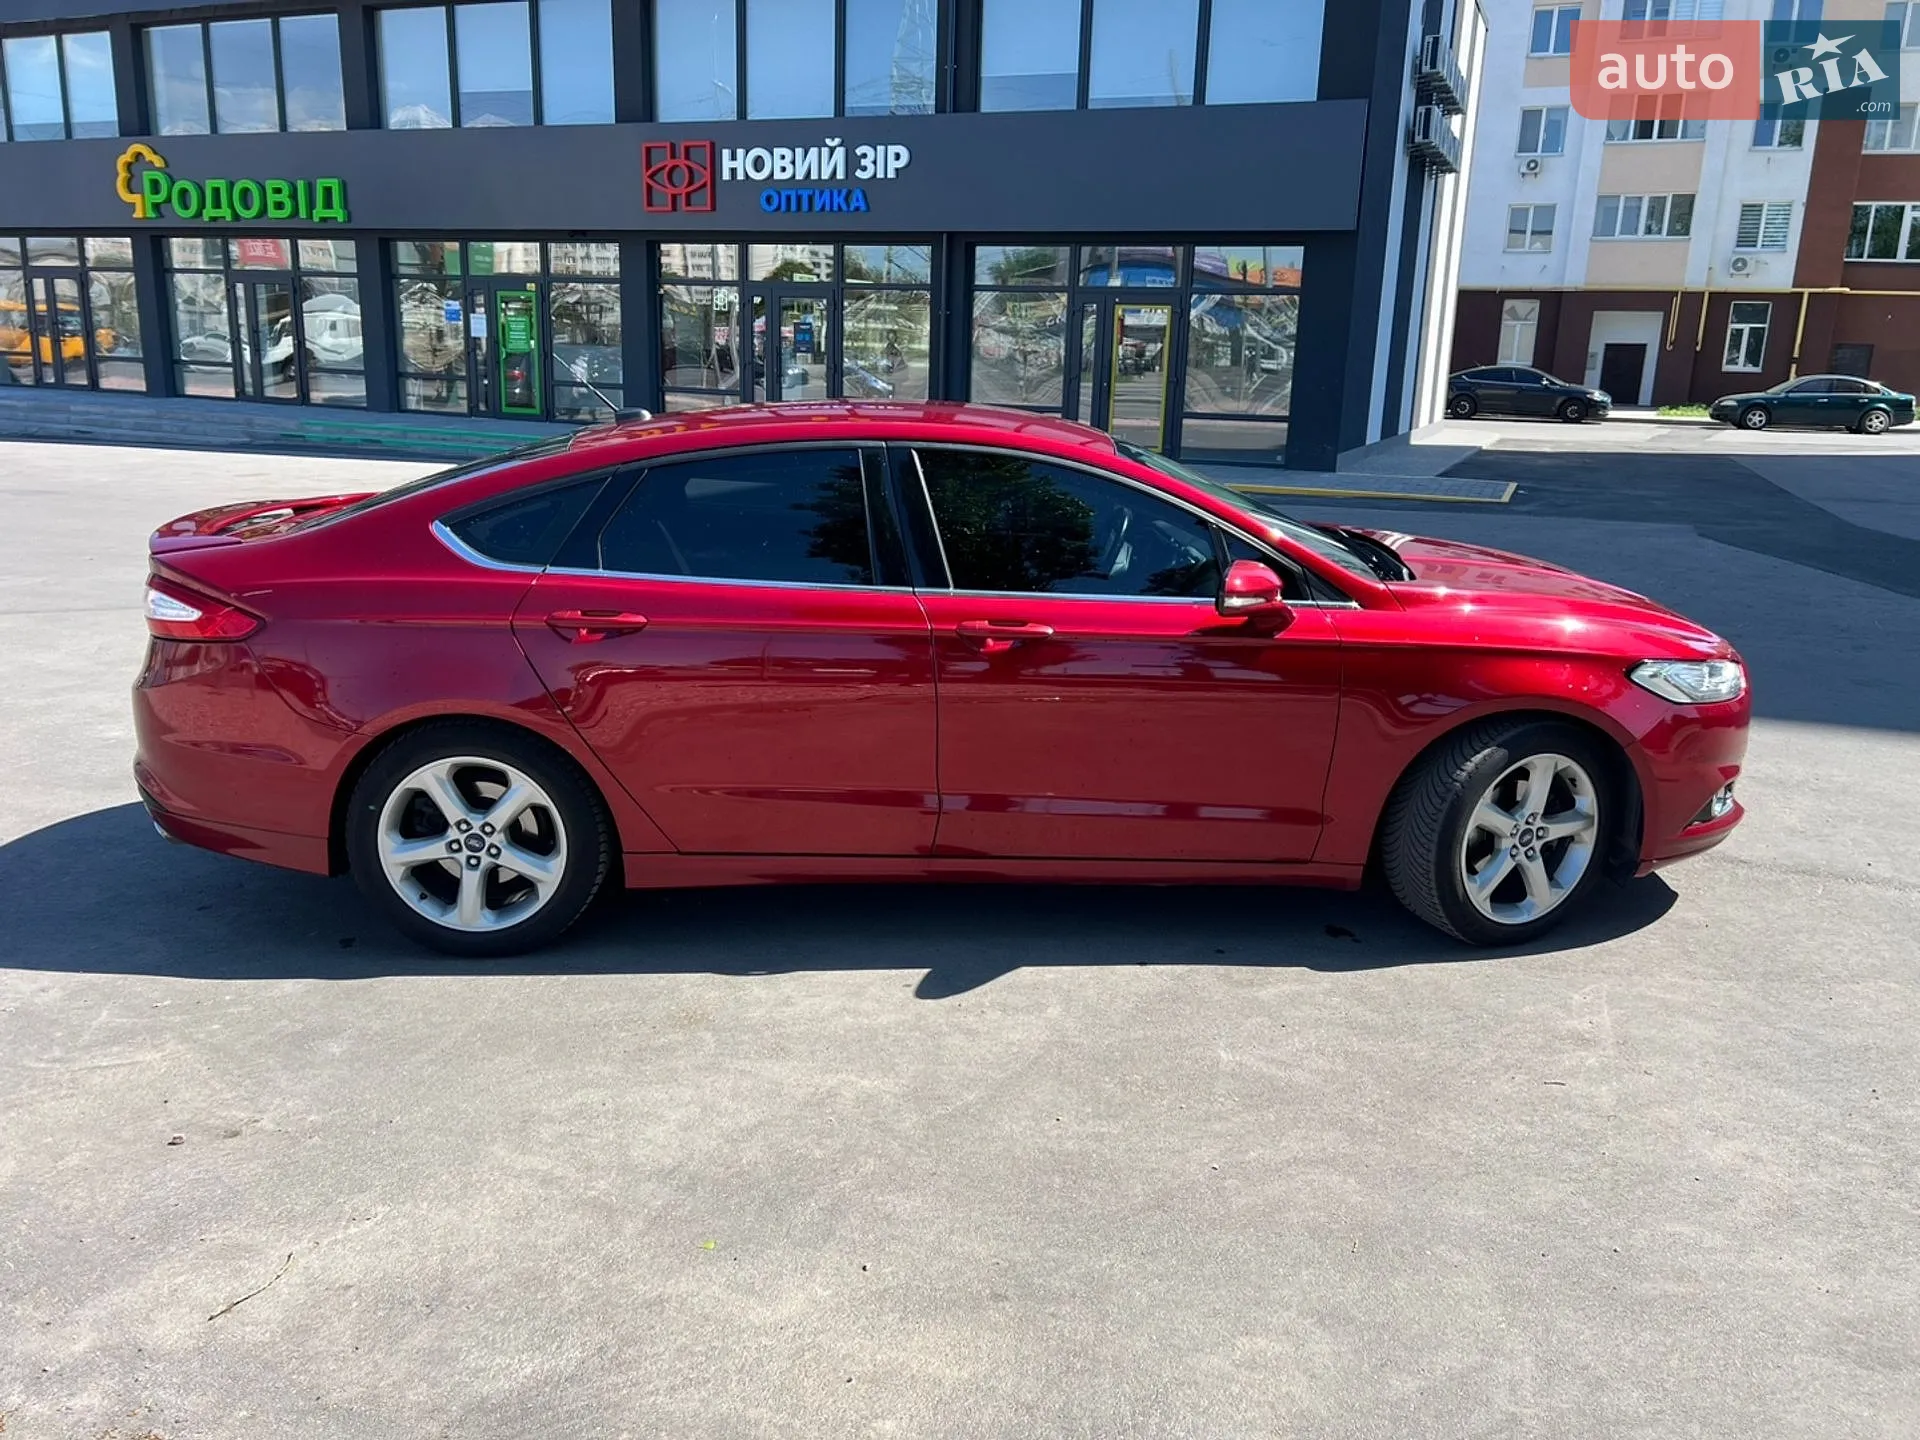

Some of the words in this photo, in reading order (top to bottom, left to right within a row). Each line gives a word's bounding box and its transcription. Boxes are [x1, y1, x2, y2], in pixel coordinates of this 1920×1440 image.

[721, 137, 847, 181] НОВИЙ
[854, 144, 911, 180] ЗІР
[760, 187, 869, 213] ОПТИКА
